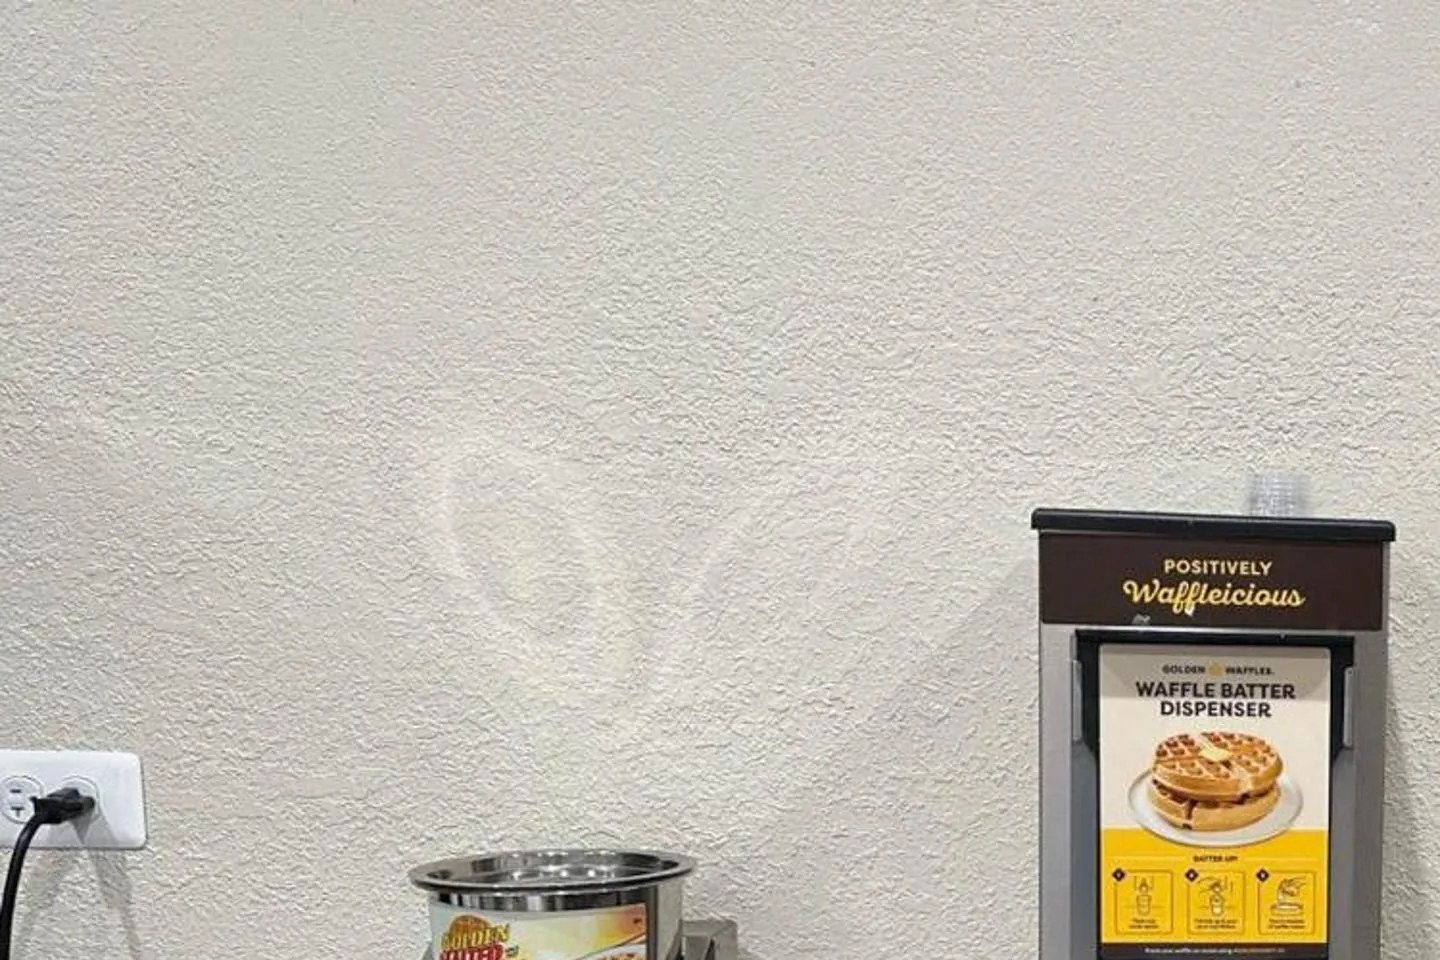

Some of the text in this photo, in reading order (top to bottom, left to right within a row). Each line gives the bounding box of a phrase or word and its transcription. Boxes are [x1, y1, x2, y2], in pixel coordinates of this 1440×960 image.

[1164, 559, 1273, 576] POSITIVELY
[1122, 578, 1306, 616] Waffleicious
[1136, 681, 1296, 699] WAFFLE BATTER
[1160, 701, 1272, 717] DISPENSER
